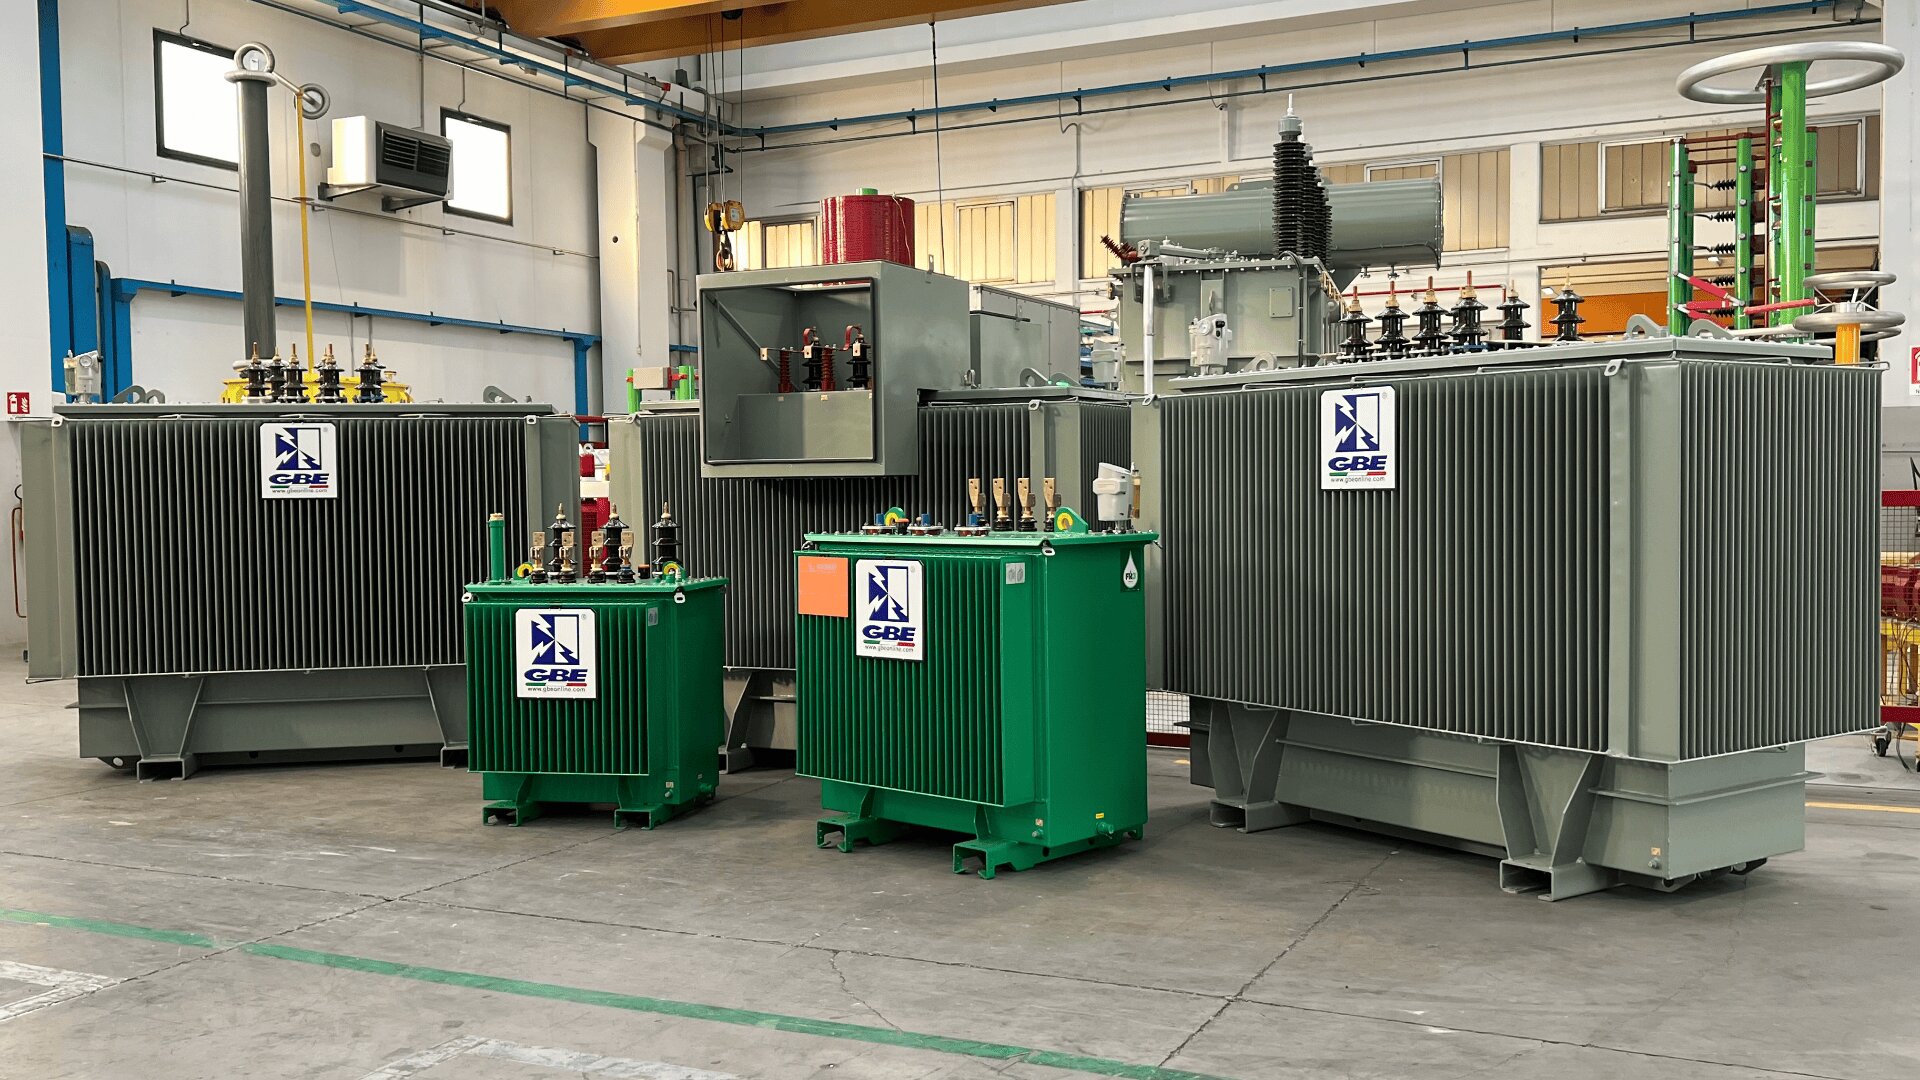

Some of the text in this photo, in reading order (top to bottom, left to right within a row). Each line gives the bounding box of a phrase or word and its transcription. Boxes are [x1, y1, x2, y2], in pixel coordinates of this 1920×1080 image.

[1328, 455, 1387, 471] GBE
[269, 473, 329, 484] GBE
[862, 625, 916, 641] GBE
[524, 668, 588, 682] GBE
